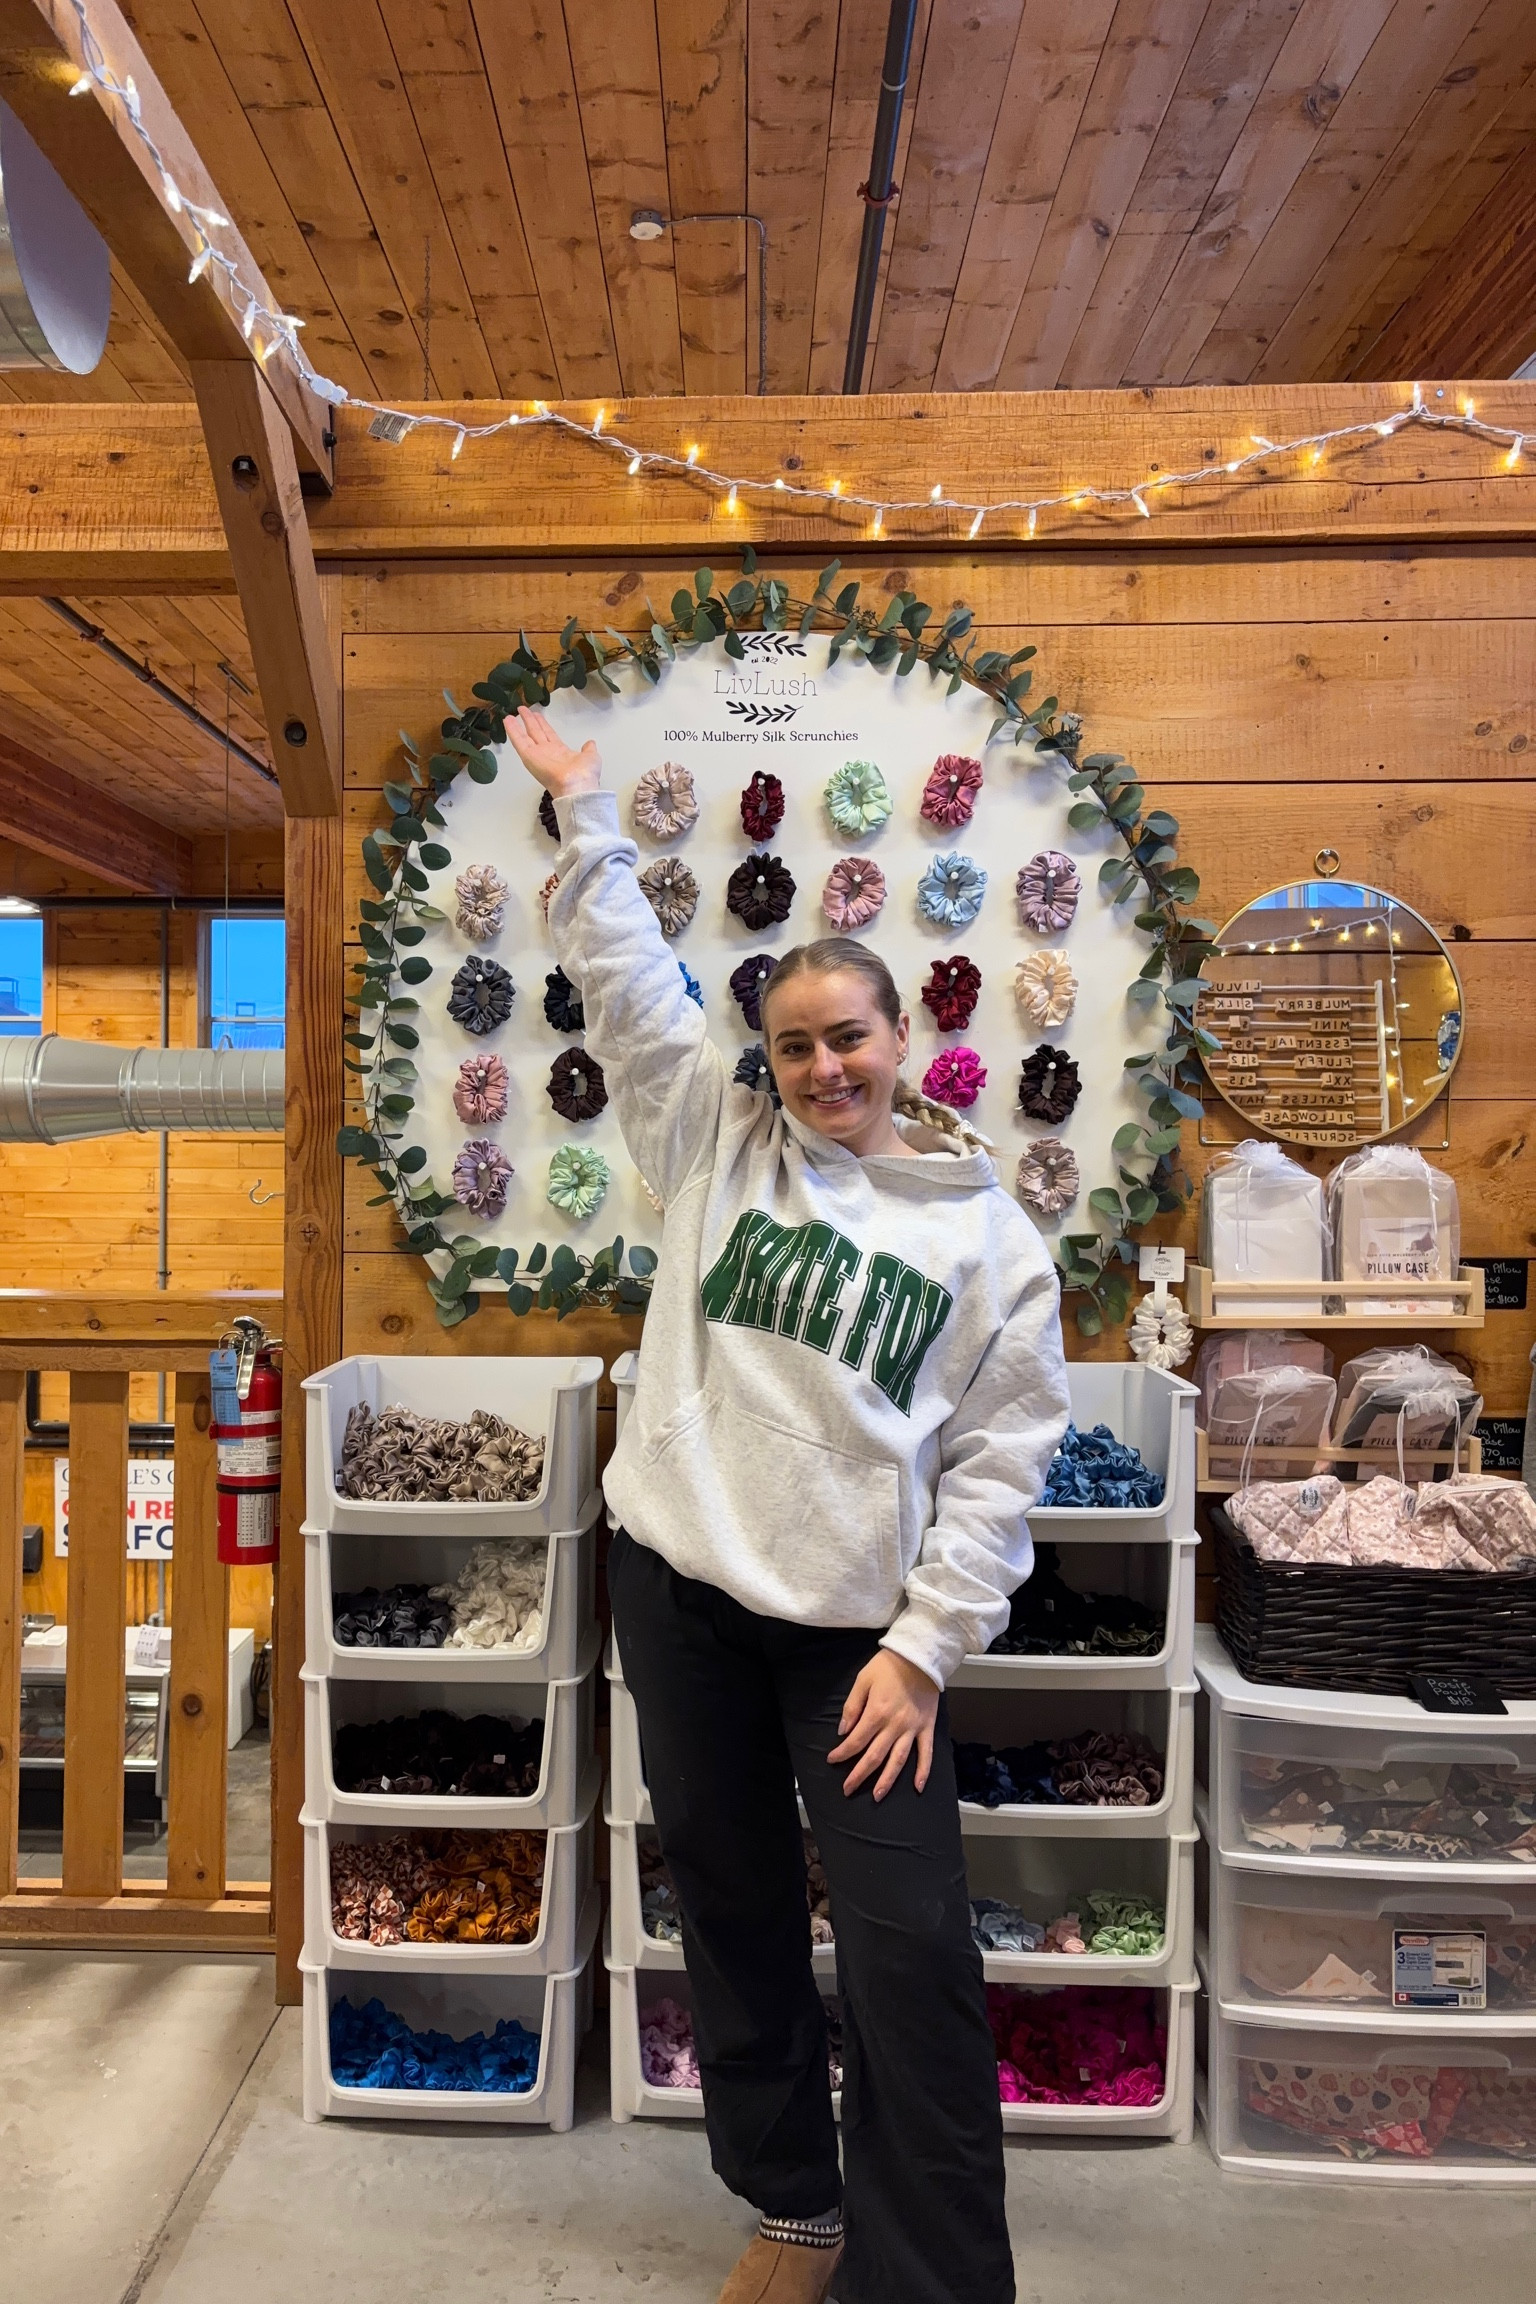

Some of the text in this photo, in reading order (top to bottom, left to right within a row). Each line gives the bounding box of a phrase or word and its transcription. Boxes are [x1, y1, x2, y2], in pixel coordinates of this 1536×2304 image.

[761, 655, 779, 665] 2022
[714, 669, 818, 697] LivLush
[664, 729, 859, 745] 100% Mulberry Silk Scrunchies
[1367, 1262, 1429, 1274] PILLOW CASE
[1493, 1262, 1522, 1274] Pillow
[1497, 1294, 1519, 1304] $100
[839, 1252, 954, 1419] FOX
[1493, 1422, 1521, 1435] Pillow
[1409, 1437, 1434, 1447] CASE
[1497, 1456, 1521, 1466] $120
[1433, 1684, 1477, 1697] Pouch
[1447, 1696, 1473, 1706] $18
[1397, 1951, 1406, 1964] 3
